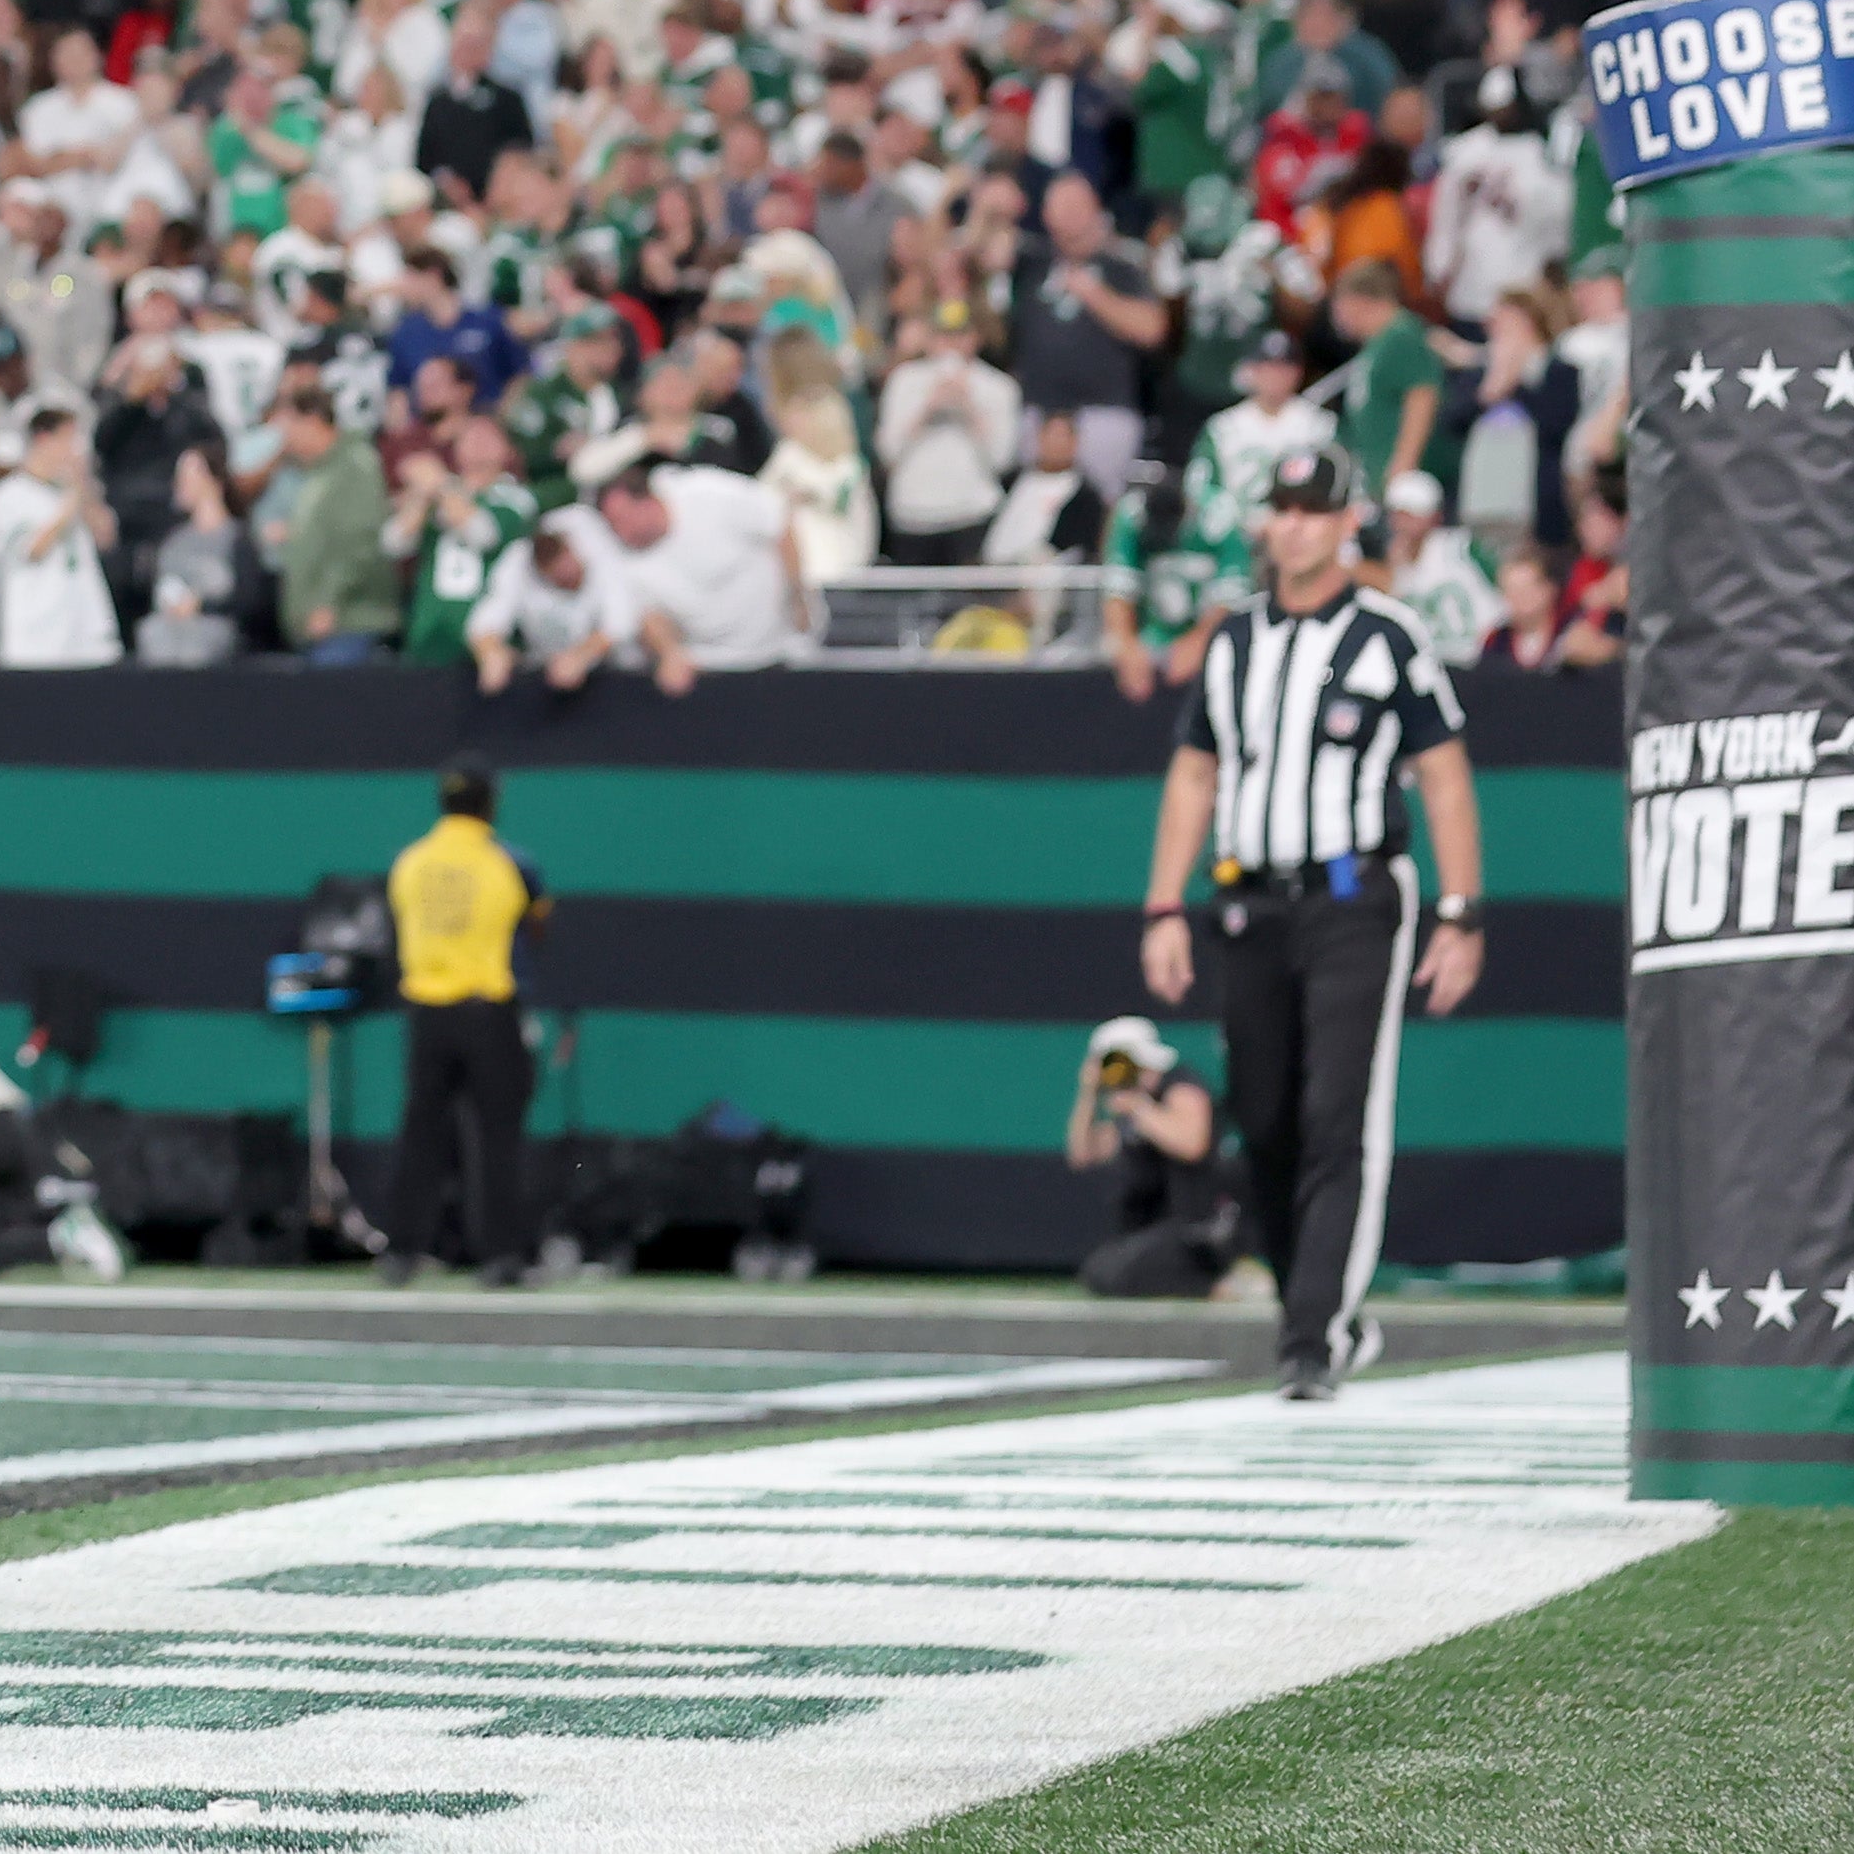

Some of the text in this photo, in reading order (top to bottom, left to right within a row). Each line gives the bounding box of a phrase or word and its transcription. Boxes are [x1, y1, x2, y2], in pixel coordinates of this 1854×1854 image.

[1629, 63, 1832, 163] LOVE
[1697, 709, 1821, 784] YORK
[1631, 774, 1854, 947] VOTE
